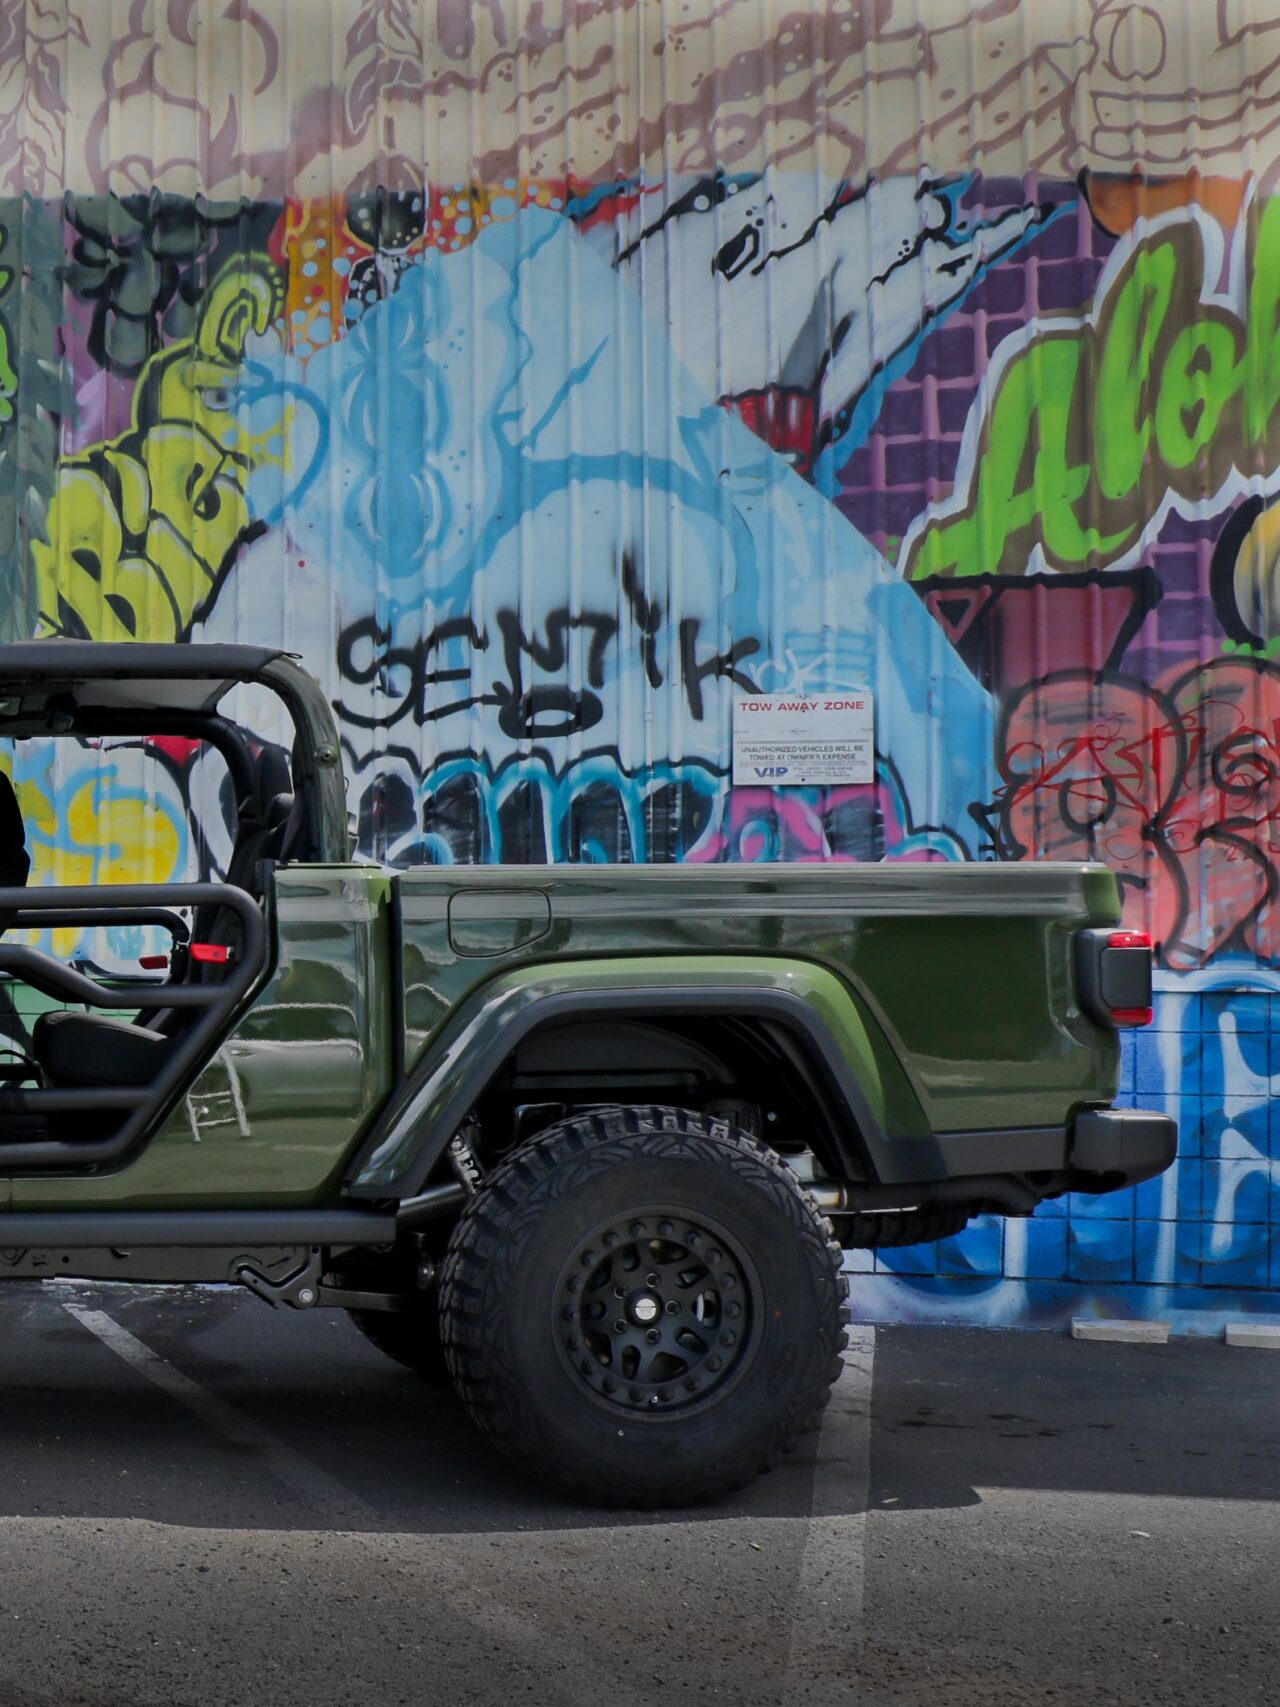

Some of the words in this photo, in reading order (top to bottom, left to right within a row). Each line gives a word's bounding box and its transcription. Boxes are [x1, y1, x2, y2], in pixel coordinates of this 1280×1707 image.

[740, 702, 772, 711] TOW
[778, 702, 818, 711] AWAY
[824, 701, 864, 710] ZONE
[754, 767, 789, 777] VIP
